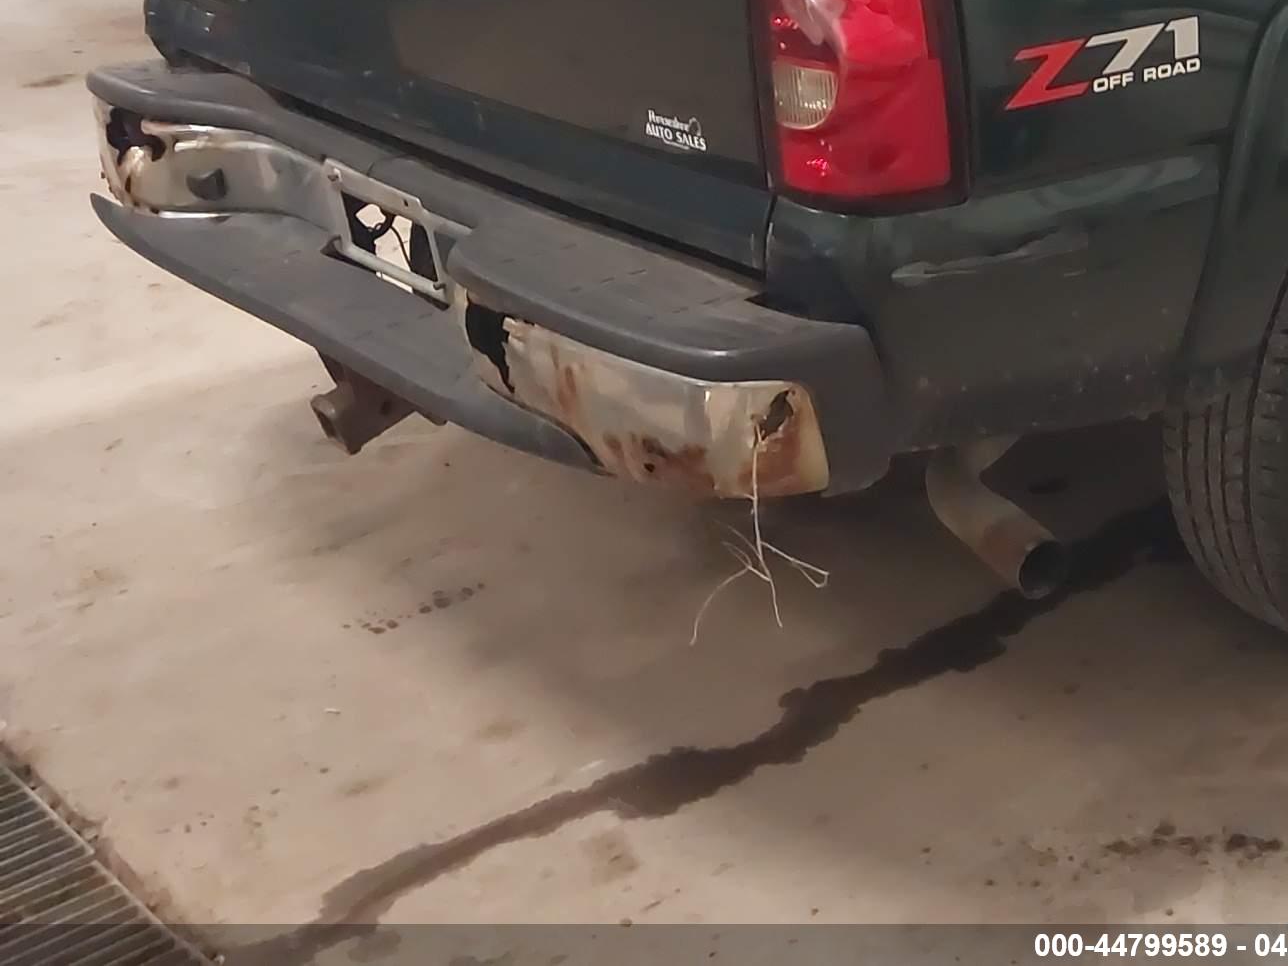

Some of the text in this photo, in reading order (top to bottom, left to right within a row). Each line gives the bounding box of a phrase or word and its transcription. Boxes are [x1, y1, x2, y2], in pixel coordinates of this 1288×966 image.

[1004, 14, 1200, 111] Z71
[1092, 57, 1201, 94] OFF ROAD
[645, 122, 707, 151] AUTO SALES
